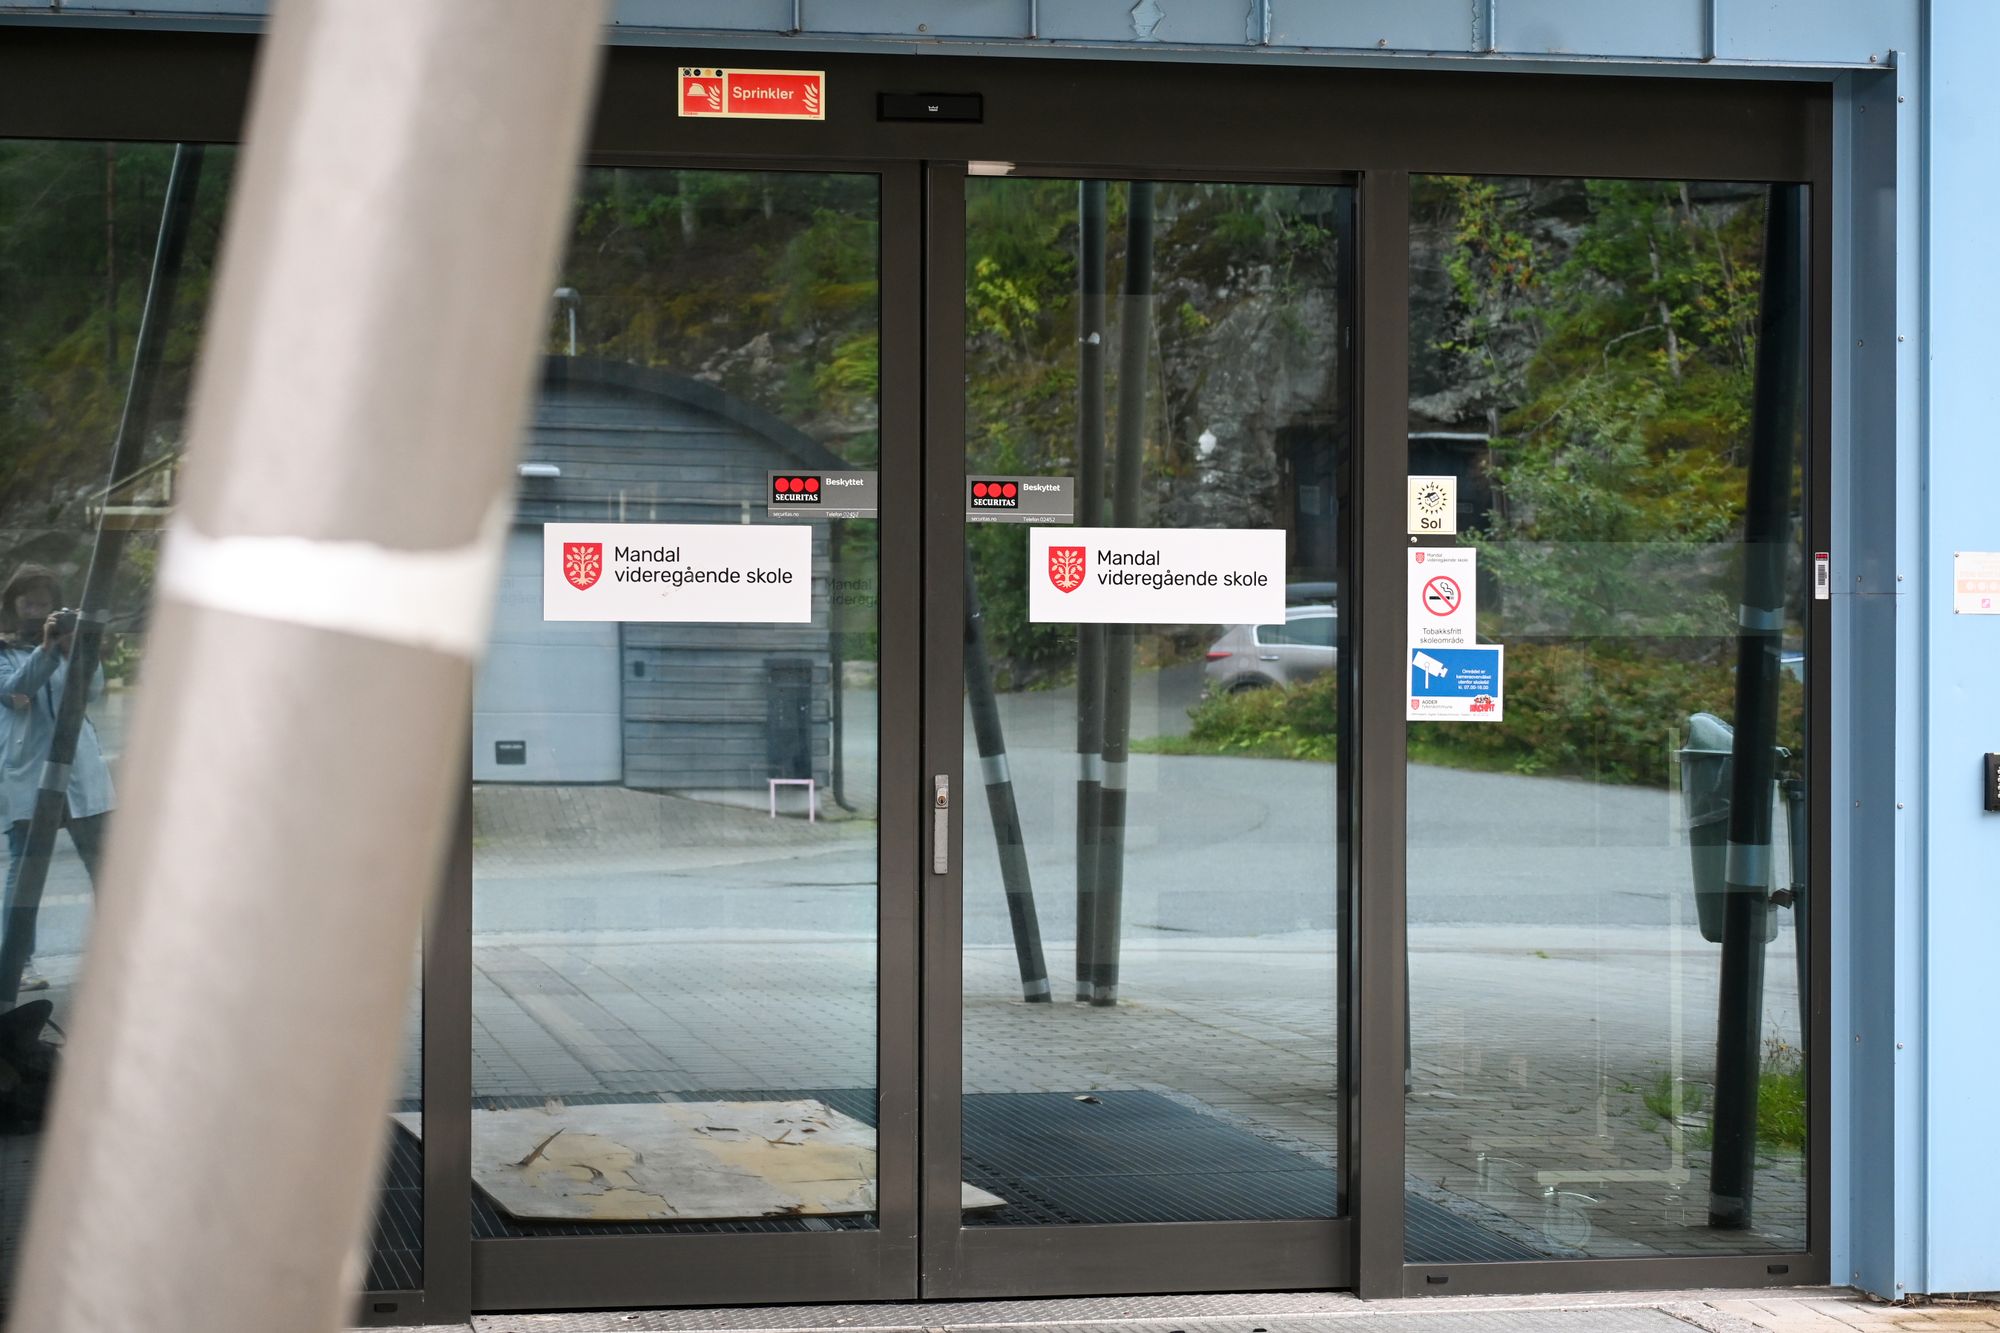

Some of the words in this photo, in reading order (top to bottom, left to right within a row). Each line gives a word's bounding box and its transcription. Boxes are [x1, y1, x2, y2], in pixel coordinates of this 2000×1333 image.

[732, 86, 795, 100] Sprinkler
[825, 478, 864, 487] Beskyttet
[1023, 483, 1061, 493] Beskyttet
[775, 493, 819, 502] SECURITAS
[973, 498, 1016, 507] SECURITAS
[1421, 517, 1442, 529] Sol
[614, 546, 680, 563] Mandal
[1097, 550, 1160, 566] Mandal
[614, 566, 741, 587] videregående
[746, 568, 793, 584] skole
[1097, 569, 1218, 590] videregående
[1223, 571, 1268, 587] skole
[1422, 627, 1462, 635] Tobakksfritt
[1420, 635, 1464, 644] skoleområde
